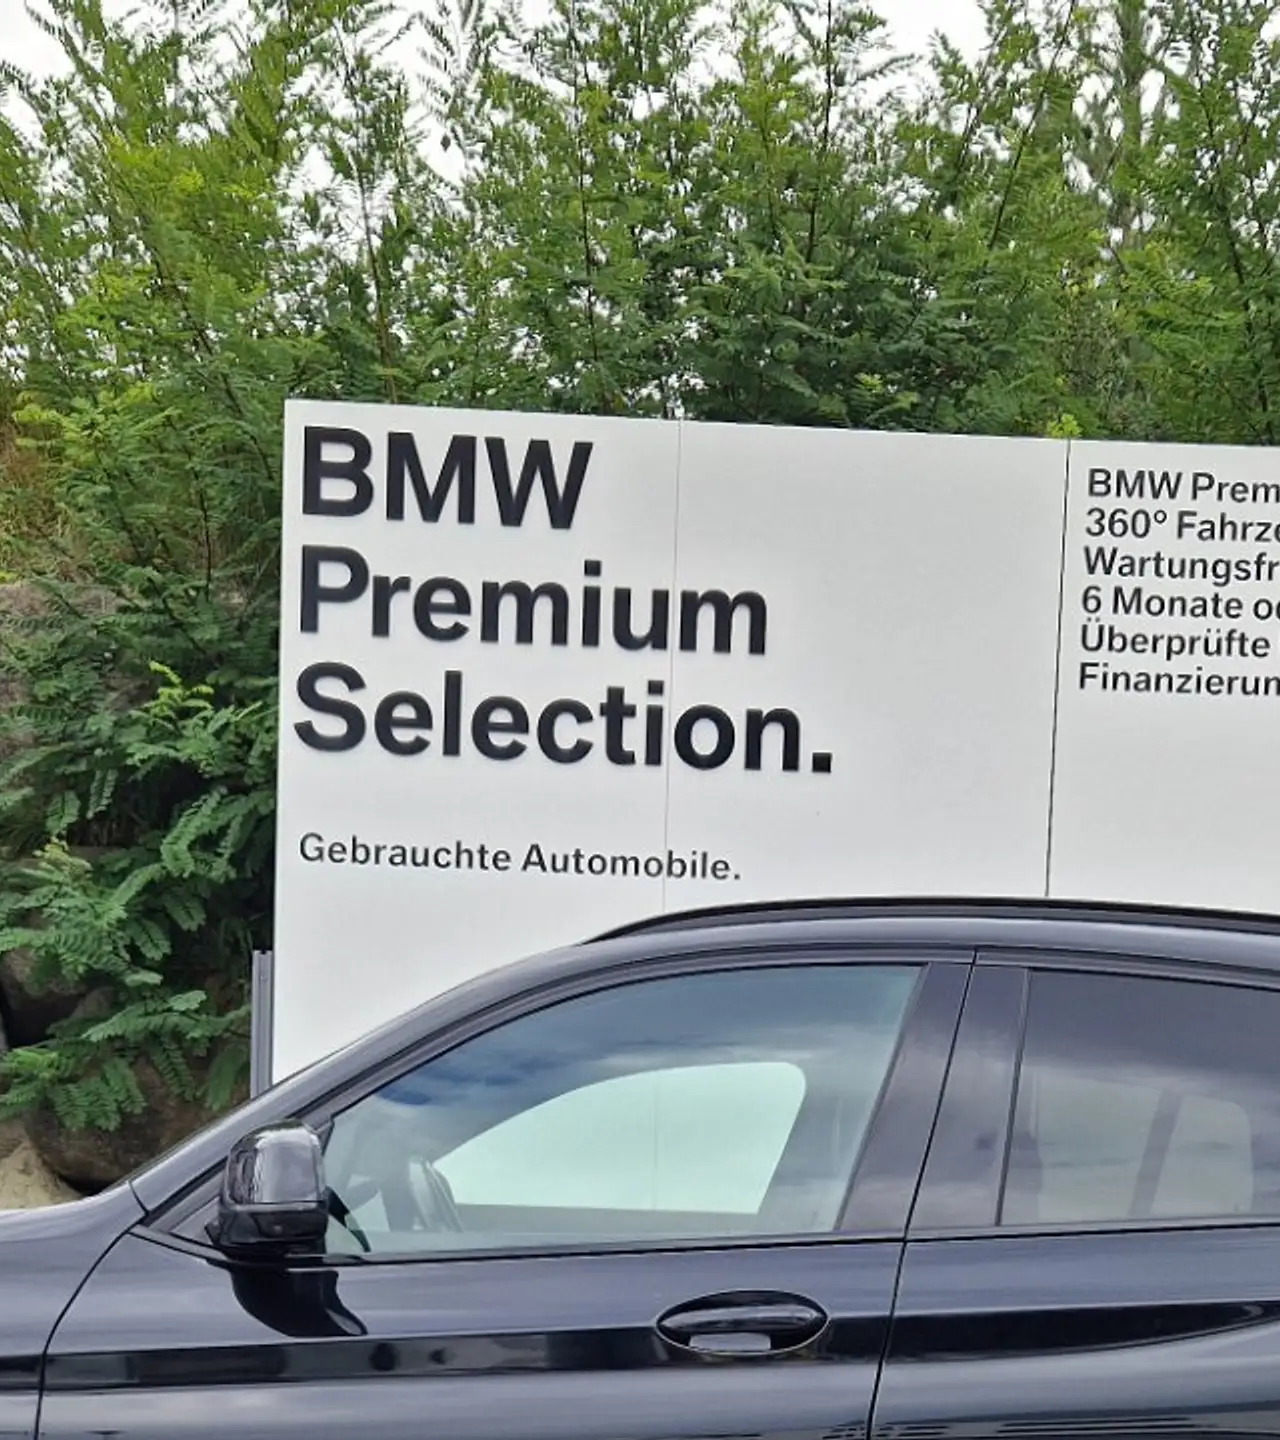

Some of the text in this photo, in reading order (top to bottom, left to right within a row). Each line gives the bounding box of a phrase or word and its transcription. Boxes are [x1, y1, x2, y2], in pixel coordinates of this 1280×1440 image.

[302, 425, 594, 531] BMW
[1088, 468, 1183, 500] BMW
[1085, 506, 1169, 539] 360°
[299, 544, 768, 656] Premium
[1081, 585, 1102, 615] 6
[1112, 585, 1244, 620] Monate
[1081, 617, 1271, 663] Überprüfte
[293, 661, 833, 775] Selection.
[299, 832, 741, 881] Gebrauchte Automobile.
